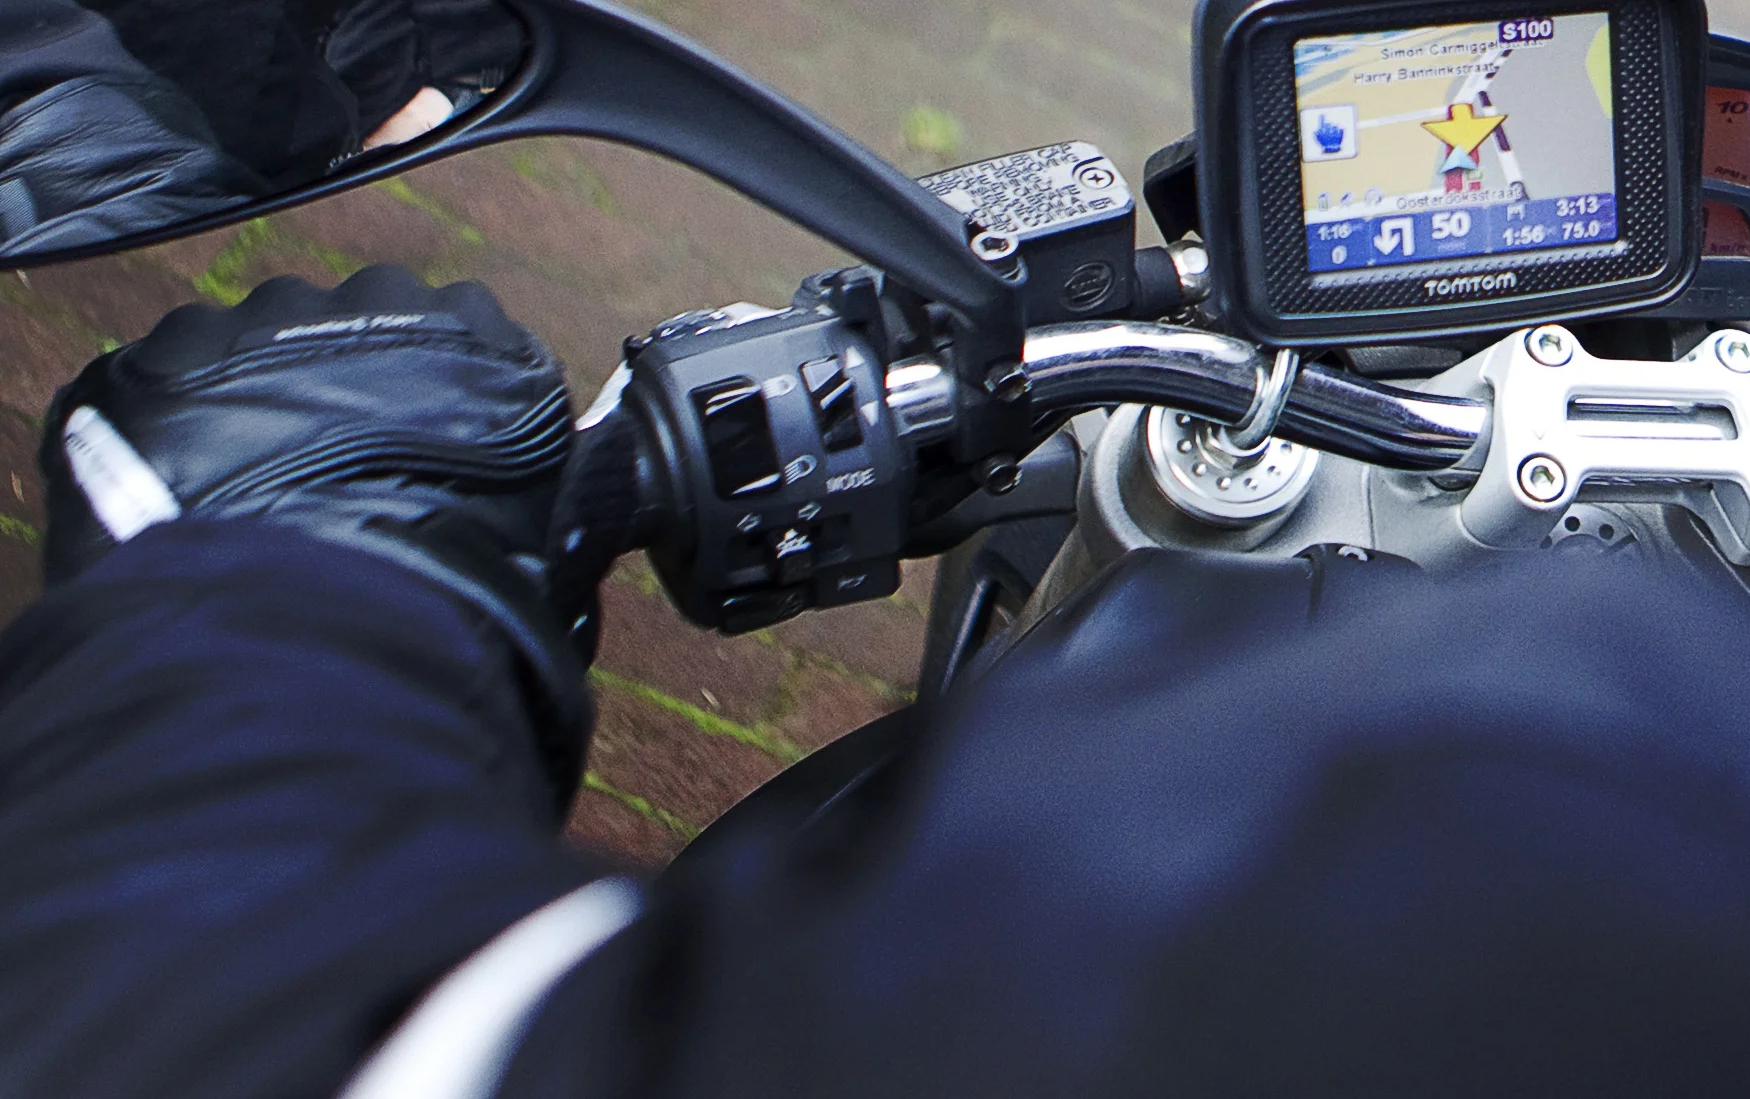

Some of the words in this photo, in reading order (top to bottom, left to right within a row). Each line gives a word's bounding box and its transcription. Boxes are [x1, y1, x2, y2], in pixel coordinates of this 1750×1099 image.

[1502, 20, 1552, 41] S100
[1380, 45, 1424, 61] Simon
[1353, 71, 1392, 84] Harry
[1719, 101, 1748, 114] 10
[1556, 195, 1600, 217] 3:13
[1431, 210, 1471, 240] 50
[1562, 220, 1601, 240] 75.0
[1331, 245, 1347, 265] 0
[826, 467, 876, 493] MODE
